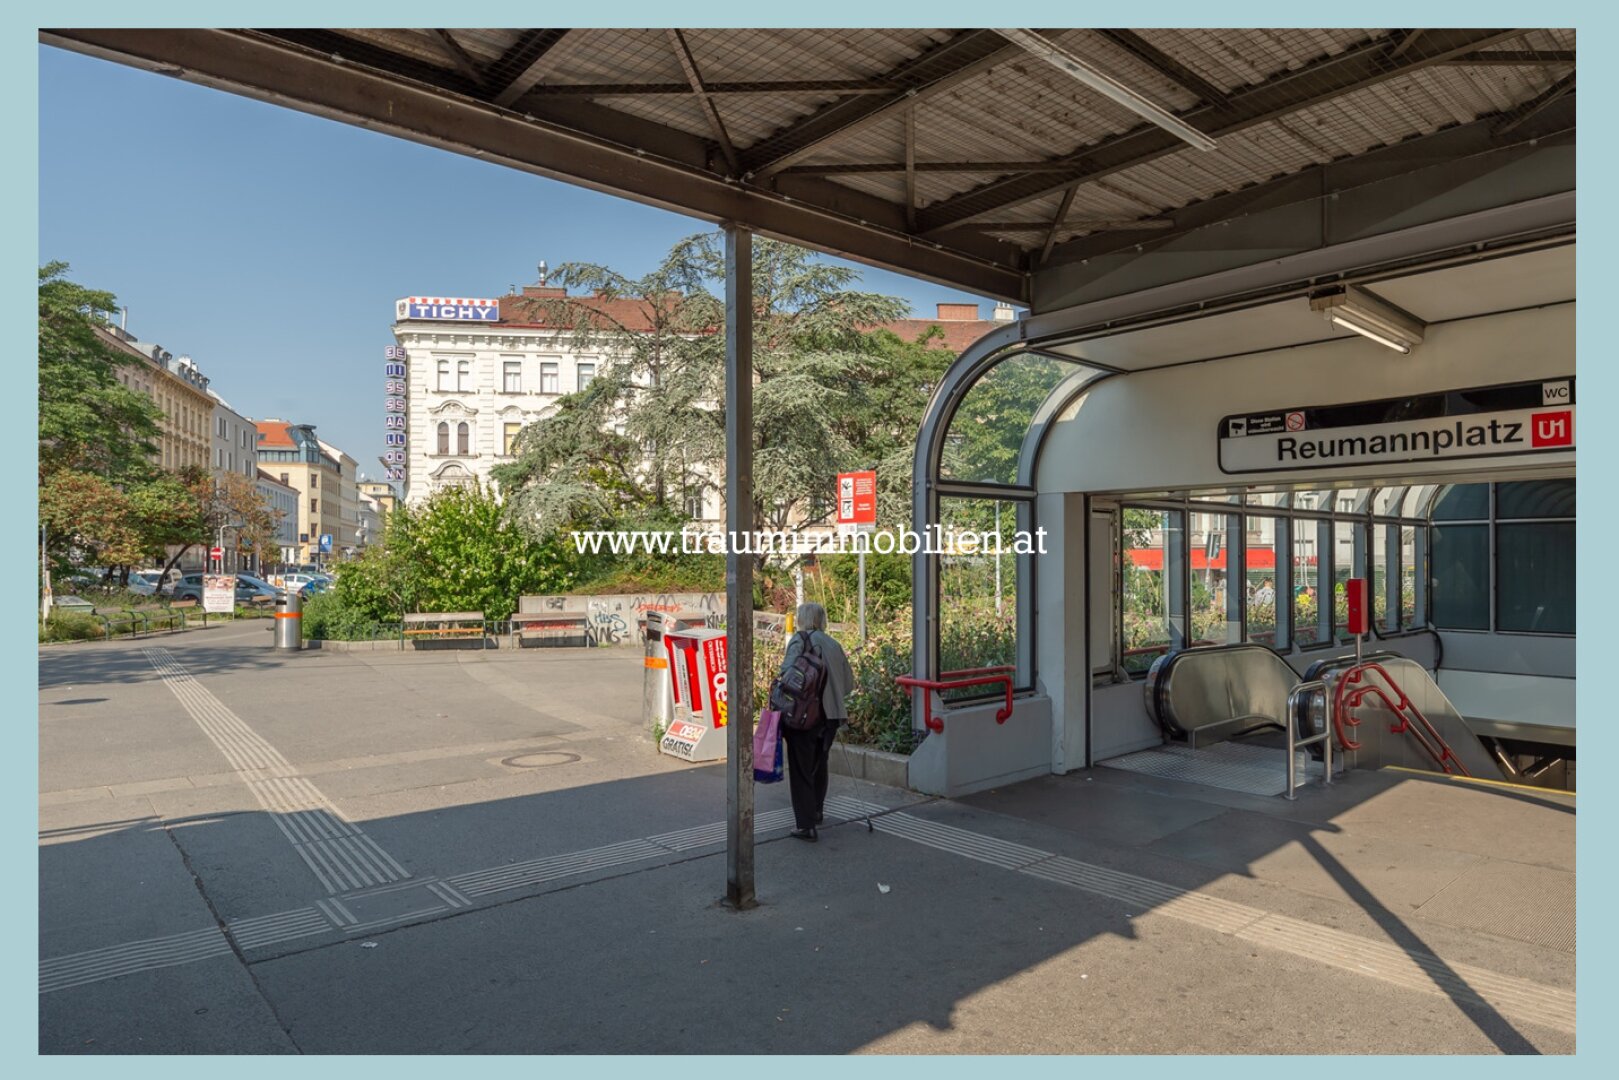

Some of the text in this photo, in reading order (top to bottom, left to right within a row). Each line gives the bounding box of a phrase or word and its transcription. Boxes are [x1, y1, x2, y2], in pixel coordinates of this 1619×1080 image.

[416, 305, 492, 320] TICHY
[1544, 387, 1568, 399] WC
[395, 346, 406, 481] EISSALON
[1277, 418, 1566, 461] Reumannplatz U1
[662, 737, 694, 757] GRATIS!
